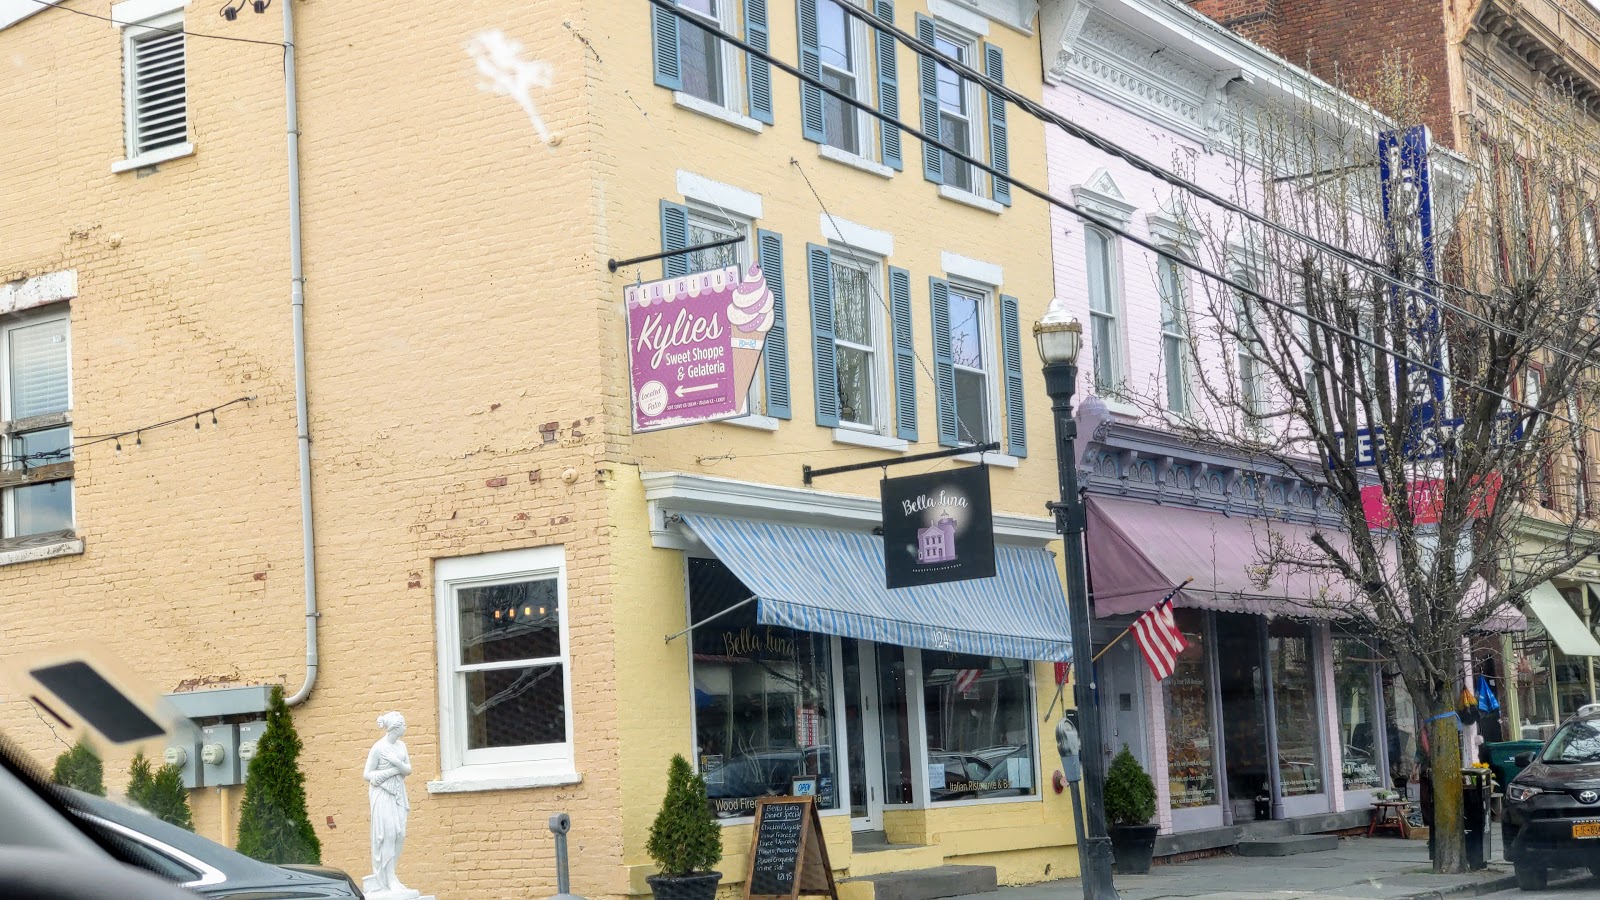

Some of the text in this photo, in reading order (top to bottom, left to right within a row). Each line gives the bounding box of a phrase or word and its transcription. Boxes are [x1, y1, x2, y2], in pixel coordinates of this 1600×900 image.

[630, 271, 734, 301] DELICIOUS
[637, 308, 723, 370] Kylies
[665, 345, 724, 366] Sweet Shoppe
[677, 360, 725, 381] & Gelateria
[902, 490, 968, 516] Bella Luna
[723, 625, 796, 658] Bella Luna
[932, 630, 949, 649] 124
[798, 783, 811, 791] OPEN
[950, 781, 968, 792] Italian
[997, 780, 1002, 789] &
[715, 799, 738, 812] Wood
